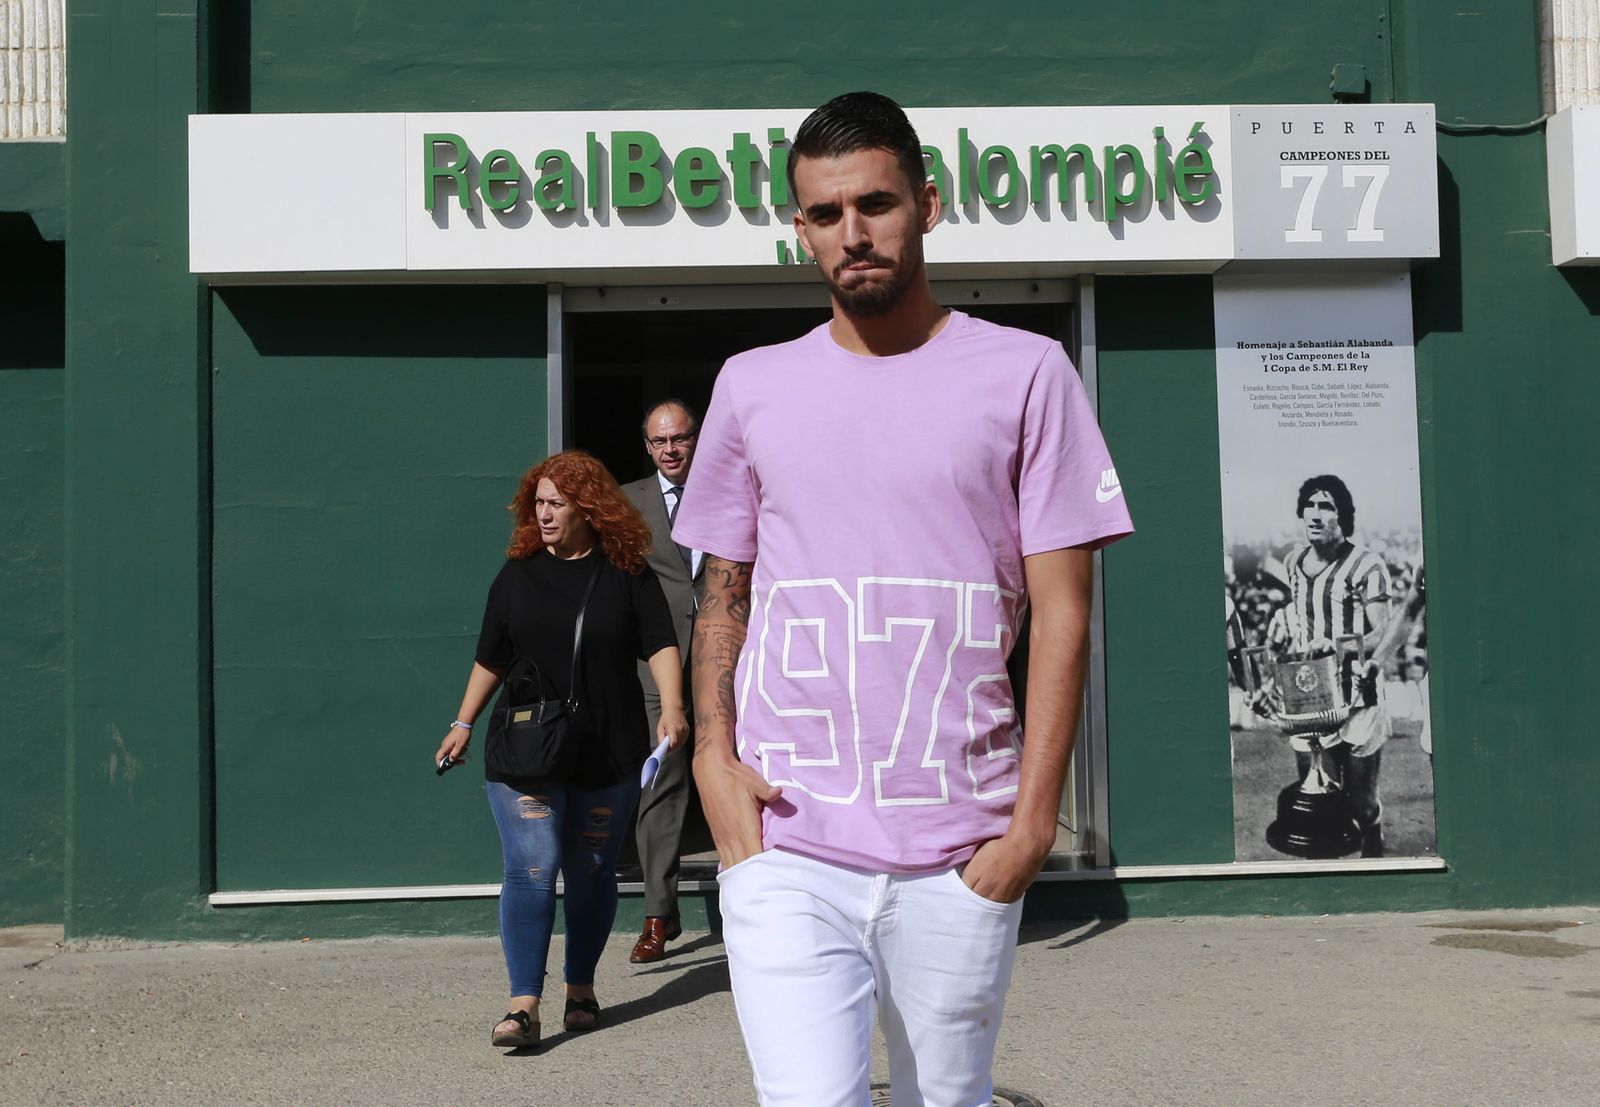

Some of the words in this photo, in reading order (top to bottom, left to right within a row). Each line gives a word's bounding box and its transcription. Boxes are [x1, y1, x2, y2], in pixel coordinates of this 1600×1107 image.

[1250, 121, 1416, 134] PUERTA
[1279, 151, 1361, 161] CAMPEONES
[1363, 150, 1390, 161] DEL
[423, 127, 790, 213] RealBeti
[920, 121, 1214, 221] alompié
[1236, 341, 1287, 350] Homenaje
[1297, 340, 1345, 349] Sebastián
[1346, 339, 1394, 348] Alabanda
[1260, 354, 1267, 363] y
[1269, 352, 1284, 361] los
[1286, 352, 1344, 362] Campeones
[1346, 351, 1358, 359] de
[1360, 350, 1371, 359] la
[1263, 364, 1269, 373] I
[1270, 364, 1297, 375] Copa
[1298, 364, 1311, 372] de
[1312, 363, 1335, 372] S.M.
[1336, 363, 1347, 372] El
[1349, 363, 1369, 373] Rey
